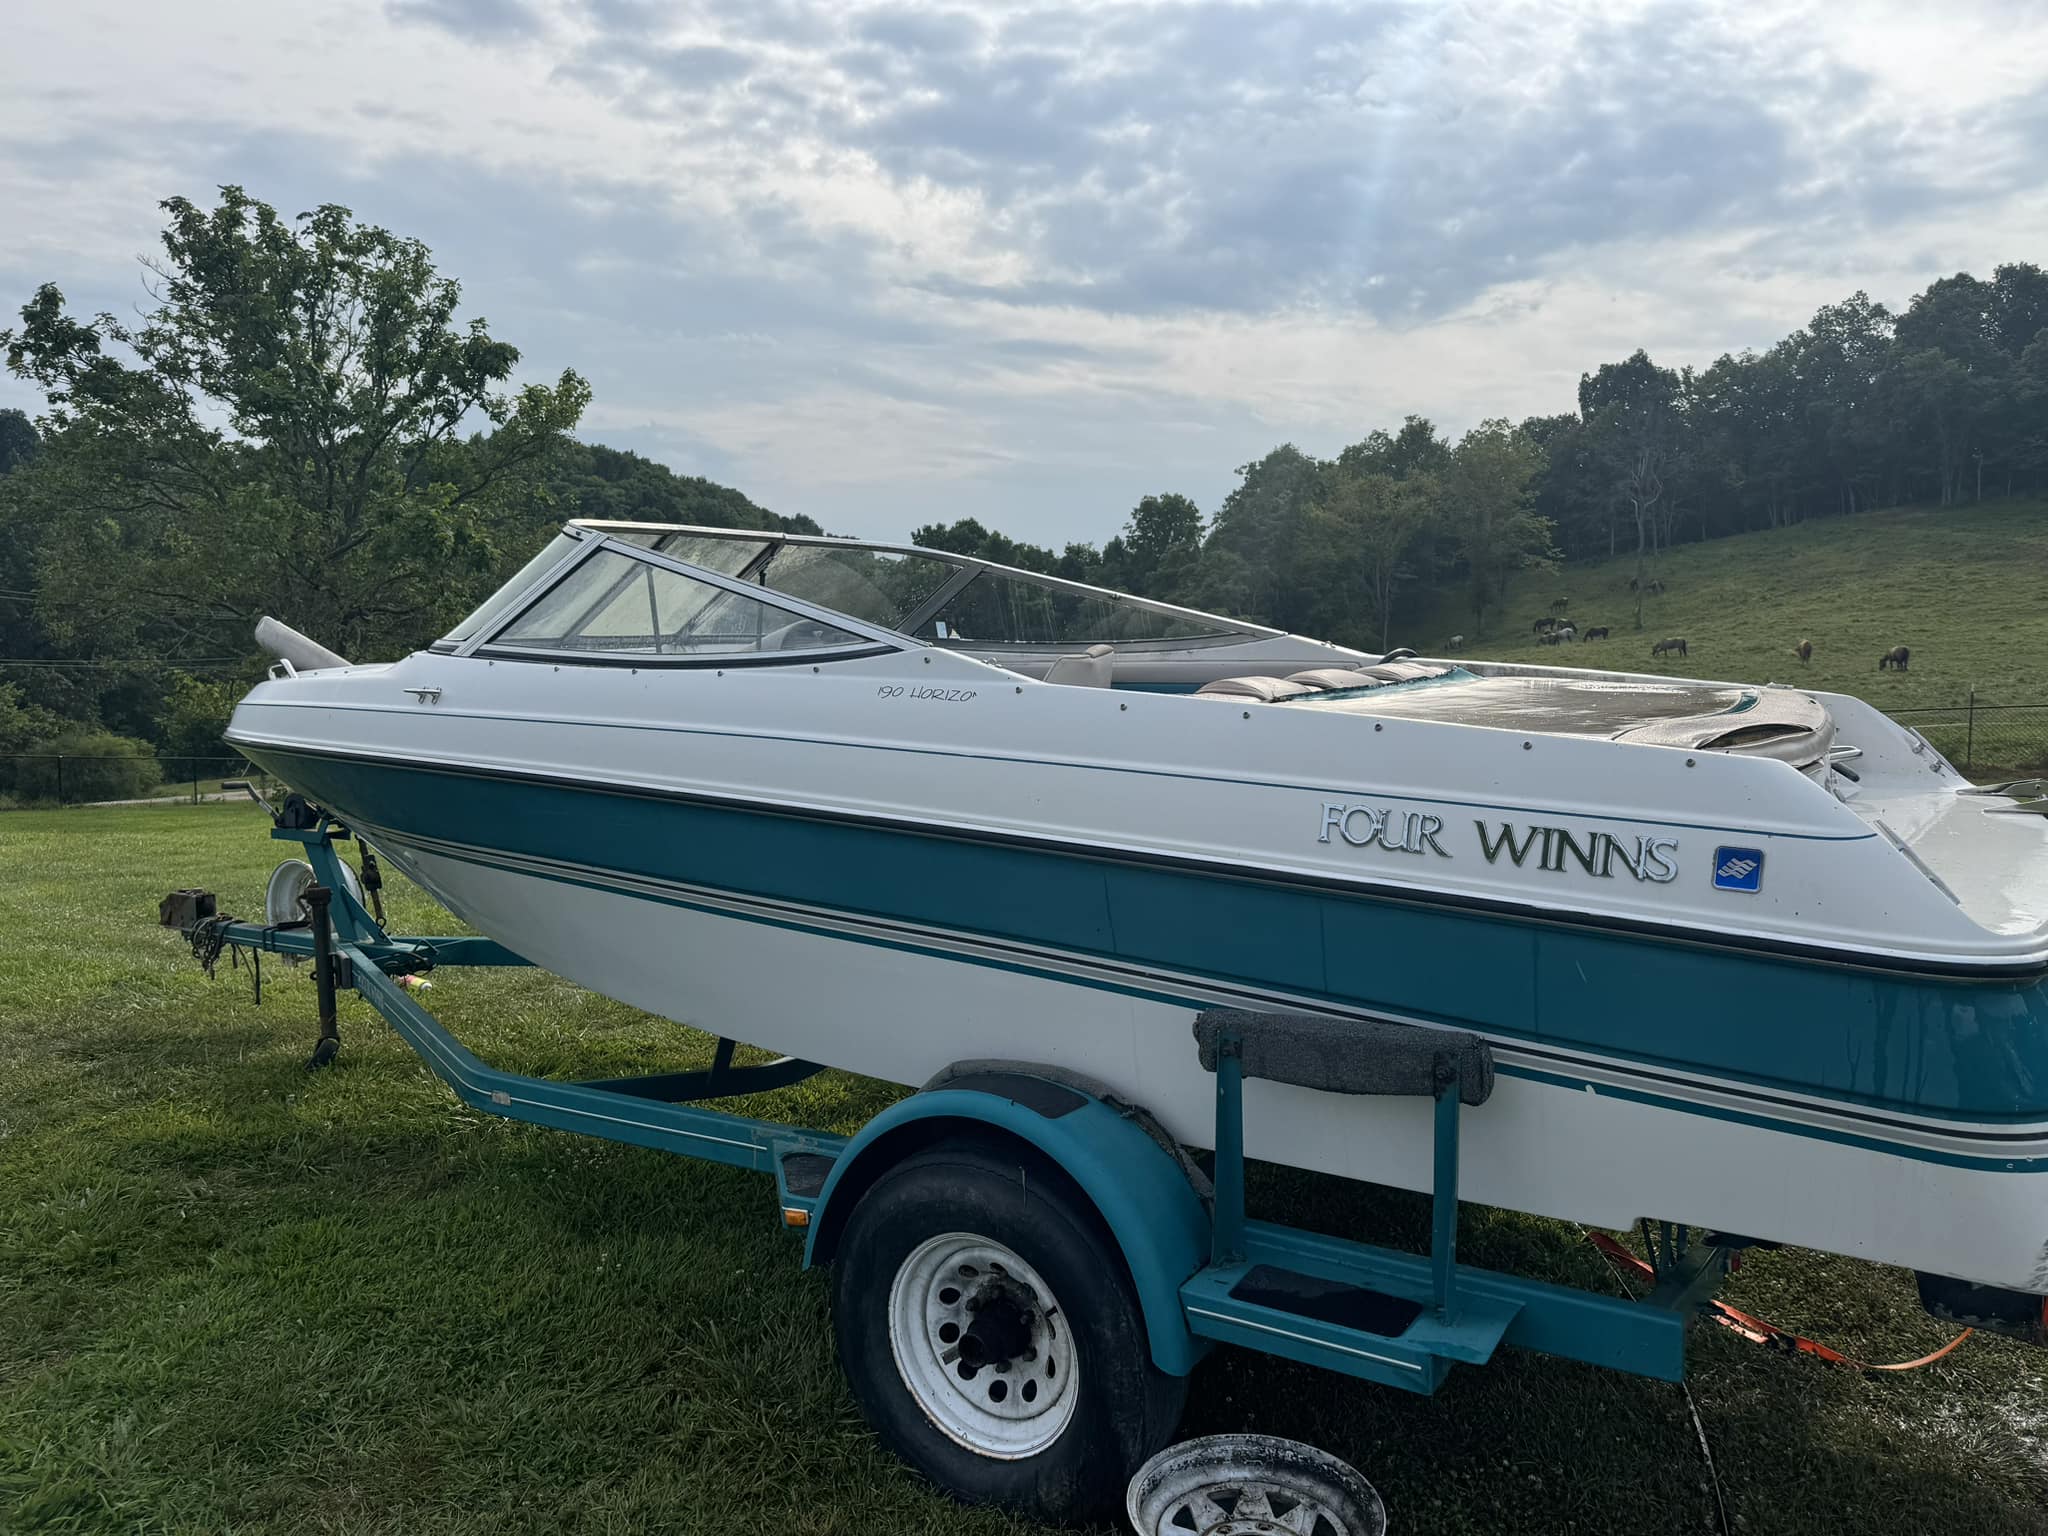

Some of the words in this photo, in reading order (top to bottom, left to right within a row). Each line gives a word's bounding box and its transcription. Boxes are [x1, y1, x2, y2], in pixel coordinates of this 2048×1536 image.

[877, 685, 904, 699] 190
[1316, 802, 1453, 858] FOUR
[1473, 819, 1679, 884] WINNS
